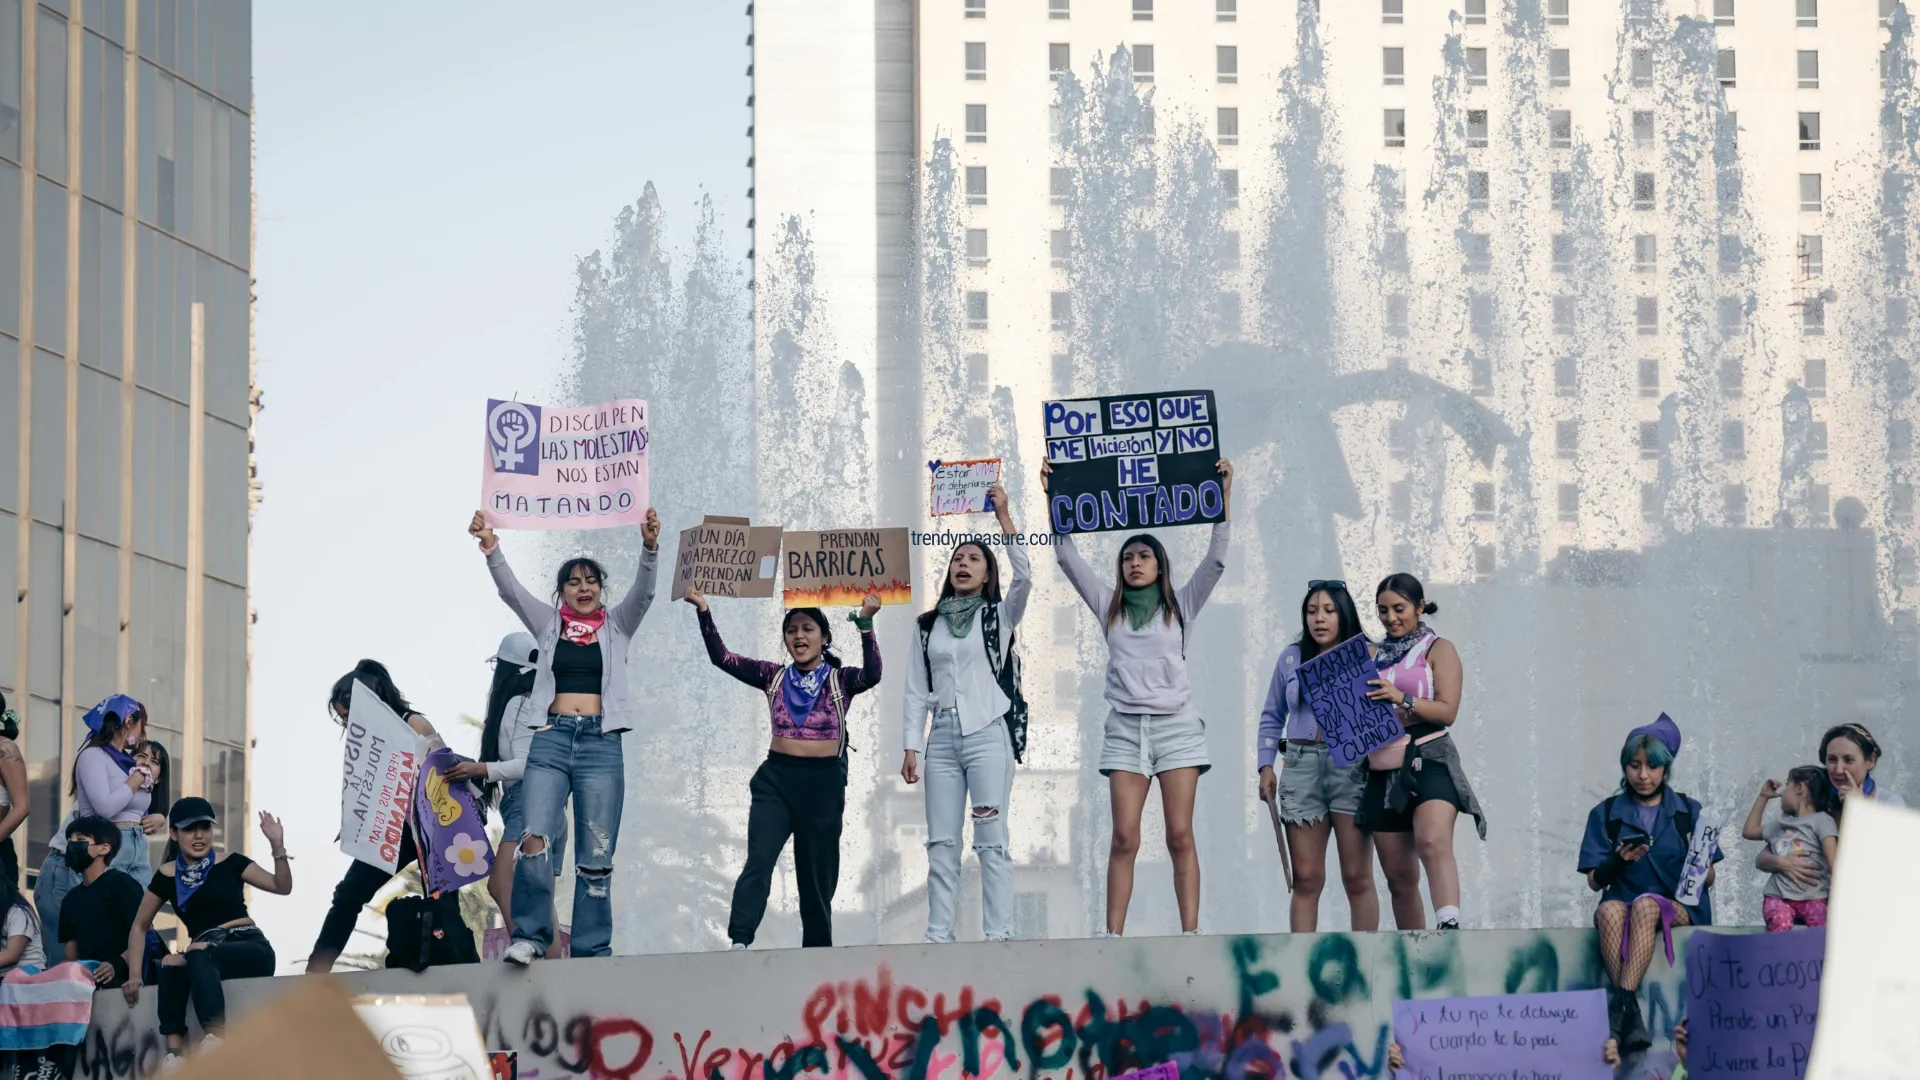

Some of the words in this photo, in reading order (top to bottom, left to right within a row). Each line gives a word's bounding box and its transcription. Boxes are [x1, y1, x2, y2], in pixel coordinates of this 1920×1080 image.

[550, 406, 644, 433] DISCULPEN
[1110, 401, 1150, 427] ESO
[1159, 395, 1207, 421] QUE
[541, 440, 568, 460] LAS
[1049, 439, 1084, 460] ME
[1156, 430, 1172, 453] Y
[1178, 427, 1212, 453] NO
[557, 467, 588, 484] NOS
[595, 460, 639, 483] ESTAN
[1120, 457, 1157, 485] HE
[495, 492, 632, 514] MATANDO
[1051, 480, 1223, 534] CONTADO
[687, 530, 697, 547] SI
[699, 529, 720, 544] UN
[724, 529, 746, 547] DÍA
[820, 532, 880, 549] PRENDAN
[680, 550, 693, 566] NO
[788, 548, 886, 580] BARRICAS
[681, 567, 692, 582] NO
[694, 566, 753, 582] PRENDAN
[1300, 640, 1367, 688] MARCHO
[1310, 681, 1356, 718] ESTOY
[1319, 707, 1347, 732] VIVA
[1325, 725, 1348, 749] SE
[1348, 704, 1393, 737] HASTA
[1342, 719, 1399, 762] CUANDO
[1720, 948, 1750, 989] te
[1468, 1010, 1489, 1028] no
[1708, 1001, 1757, 1030] Prende
[1766, 1014, 1788, 1030] un
[1429, 1031, 1487, 1052] cuando
